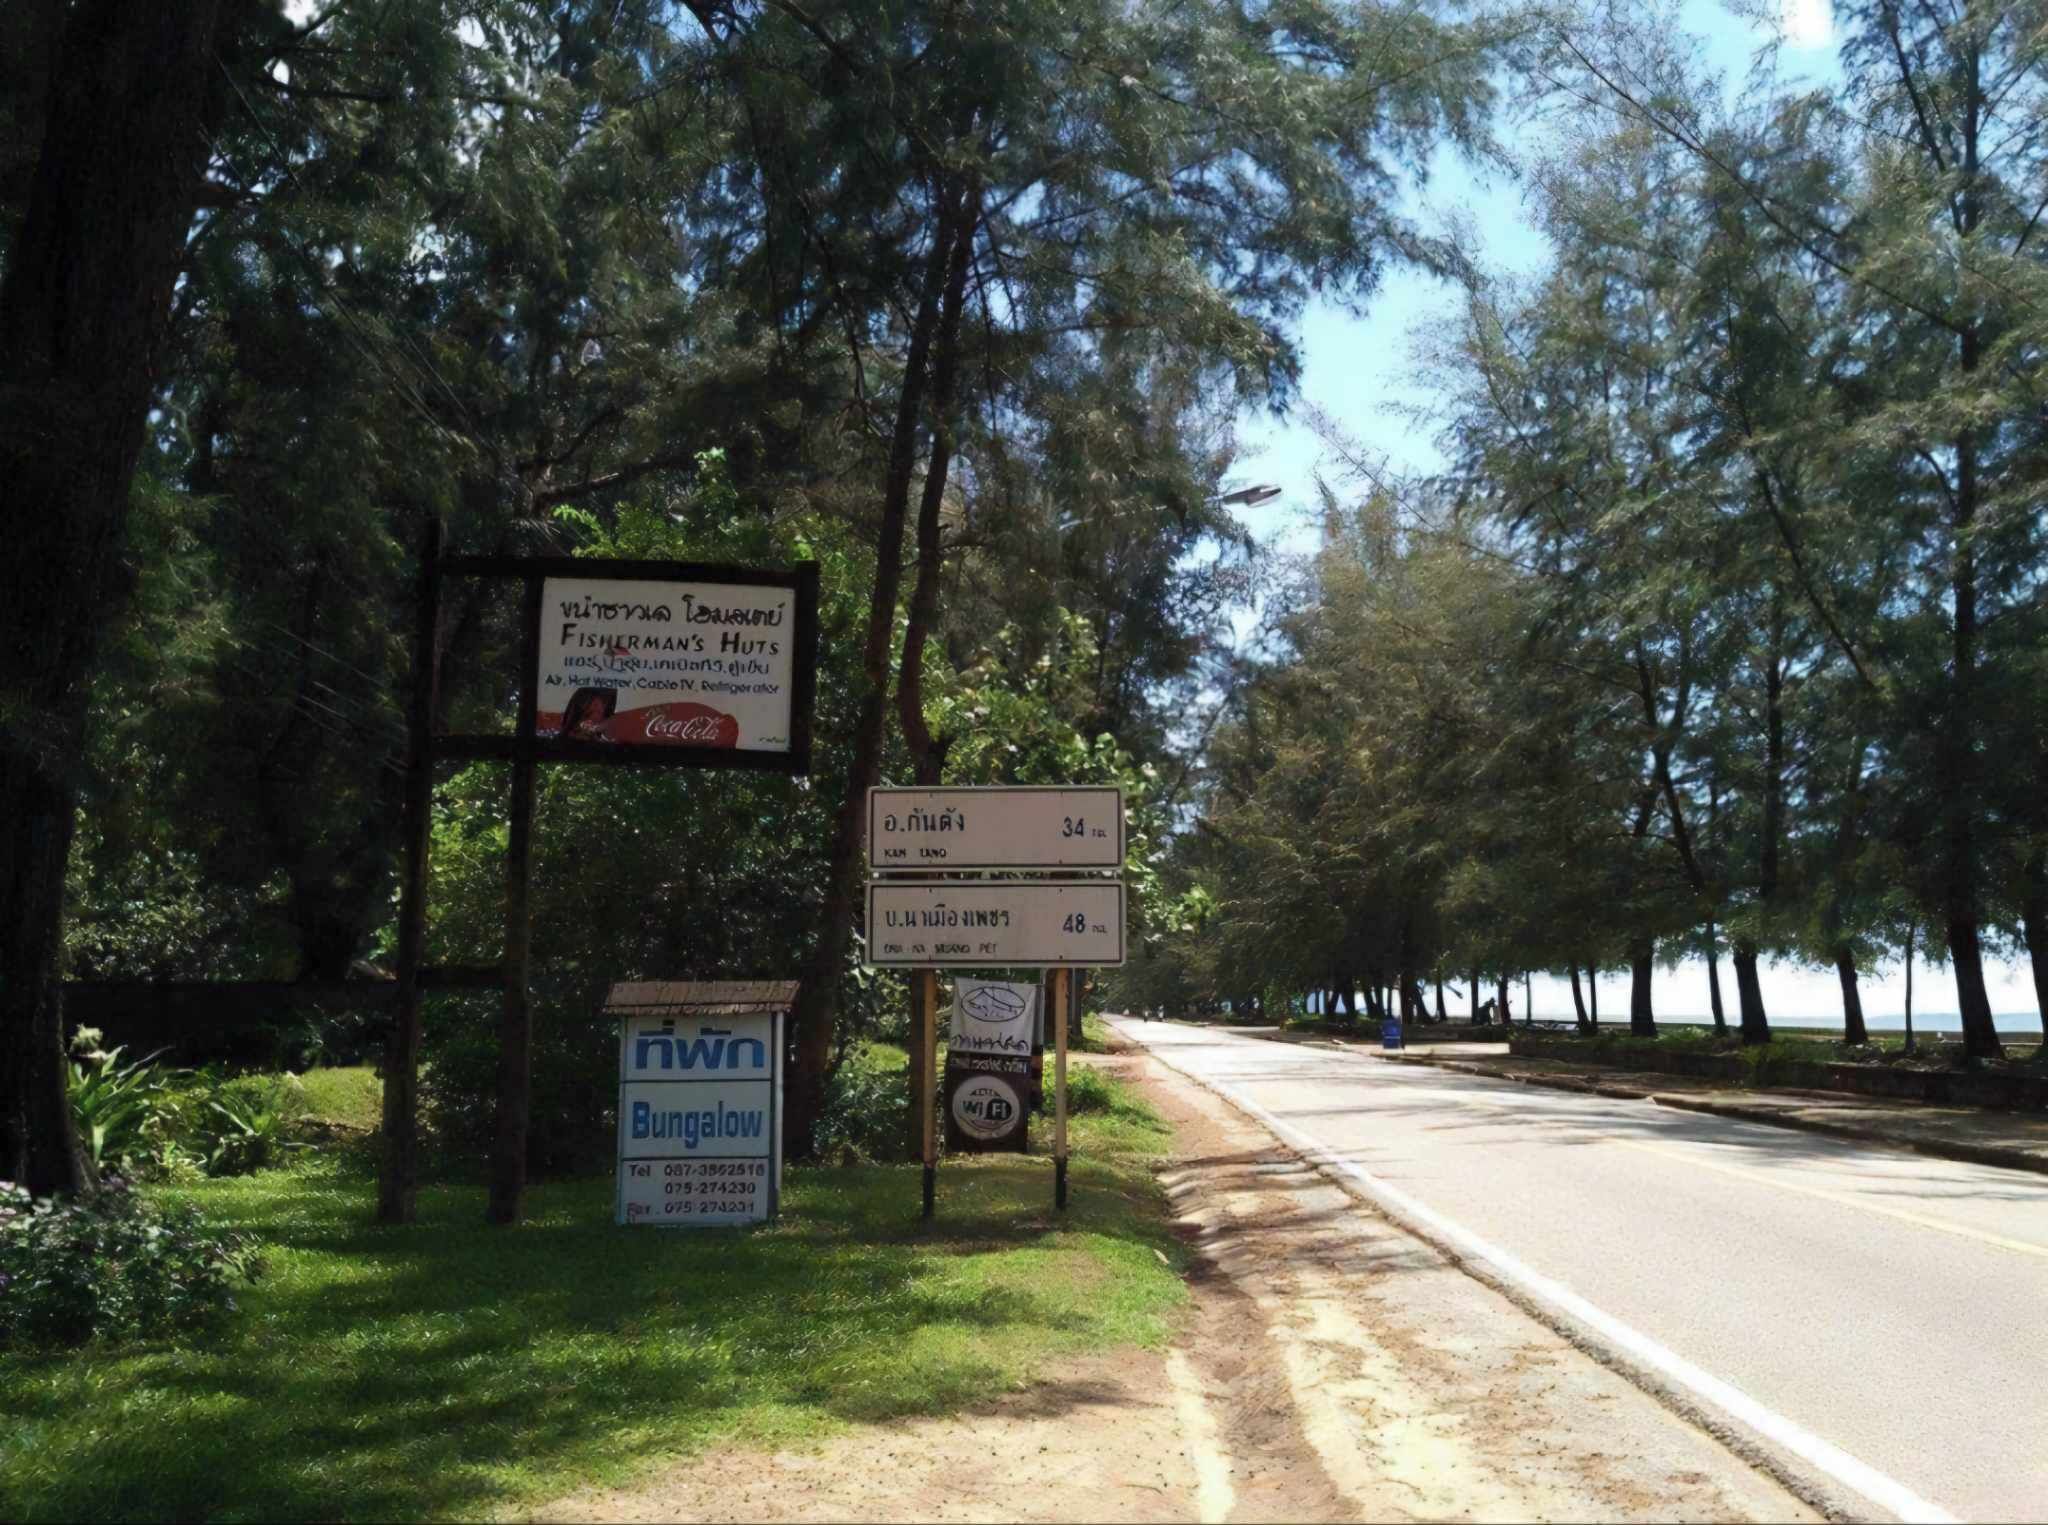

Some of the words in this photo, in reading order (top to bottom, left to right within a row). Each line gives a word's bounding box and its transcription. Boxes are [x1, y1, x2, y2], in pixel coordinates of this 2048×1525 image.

[560, 623, 704, 652] FISHERMAN'S
[721, 632, 779, 656] HUTS
[884, 808, 965, 833] อ.กันตัง
[1062, 816, 1085, 838] 34
[1062, 913, 1086, 934] 48
[631, 1101, 763, 1150] Bungalow
